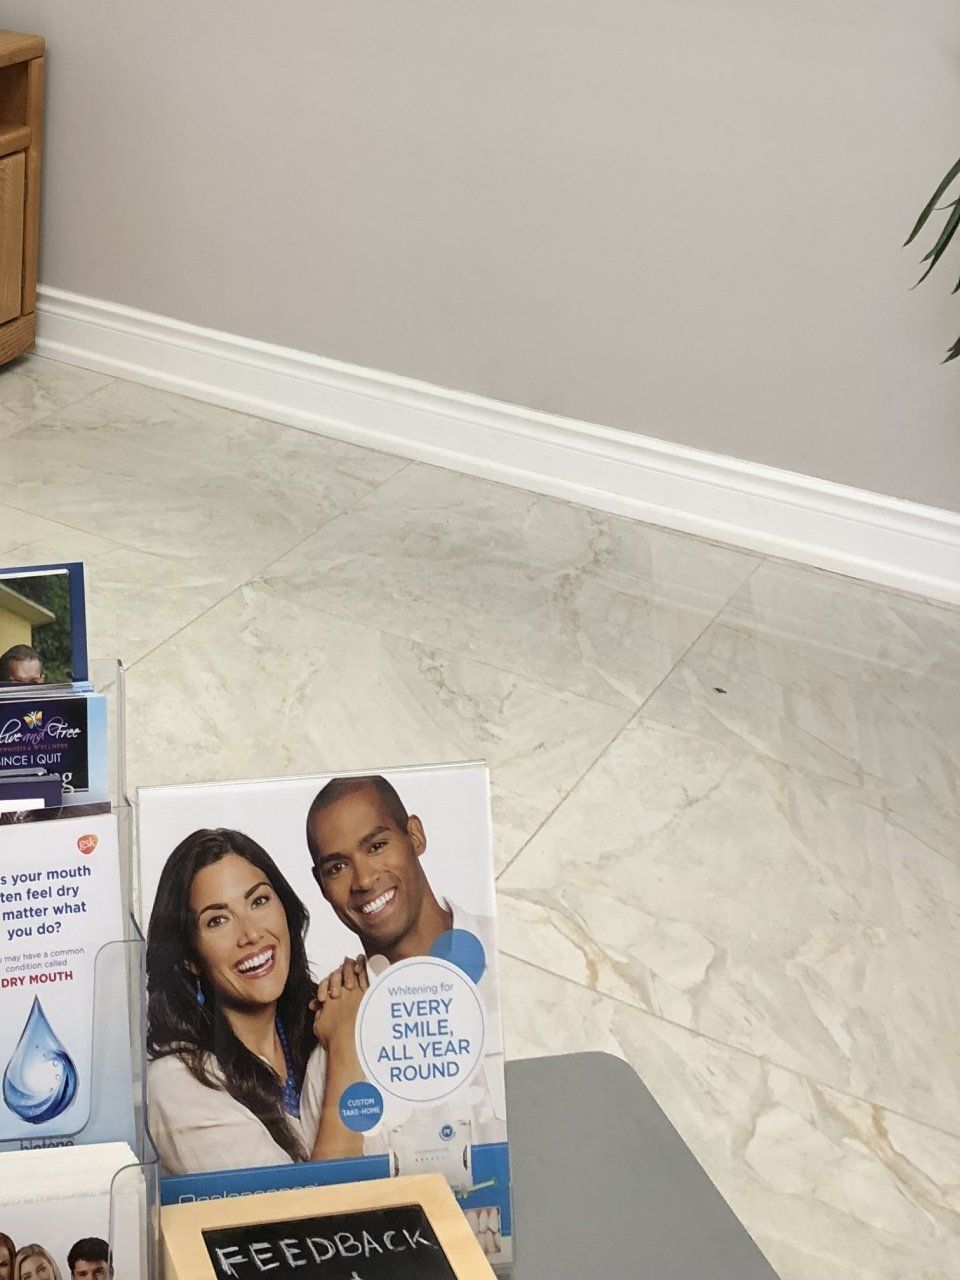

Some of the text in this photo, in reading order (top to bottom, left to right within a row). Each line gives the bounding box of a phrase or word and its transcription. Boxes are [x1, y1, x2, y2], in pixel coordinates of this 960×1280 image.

[46, 721, 81, 739] Free
[37, 753, 62, 765] QUIT
[79, 837, 96, 851] gsk
[11, 872, 42, 886] your
[46, 865, 91, 880] mouth
[26, 886, 52, 900] feel
[57, 885, 80, 898] dry
[2, 906, 49, 921] matter
[53, 901, 87, 915] what
[7, 921, 62, 941] you do?
[4, 955, 21, 964] may
[23, 951, 41, 961] have
[50, 947, 85, 958] common
[5, 958, 68, 973] condition called
[1, 970, 74, 989] DRY MOUTH
[388, 982, 454, 996] Whitening for
[390, 998, 453, 1019] EVERY
[392, 1019, 454, 1040] SMILE,
[377, 1039, 470, 1063] ALL YEAR
[390, 1061, 460, 1083] ROUND
[342, 1106, 381, 1117] TAKE-HOME
[347, 1098, 376, 1107] CUSTOM
[214, 1228, 439, 1279] FEEDBACK
